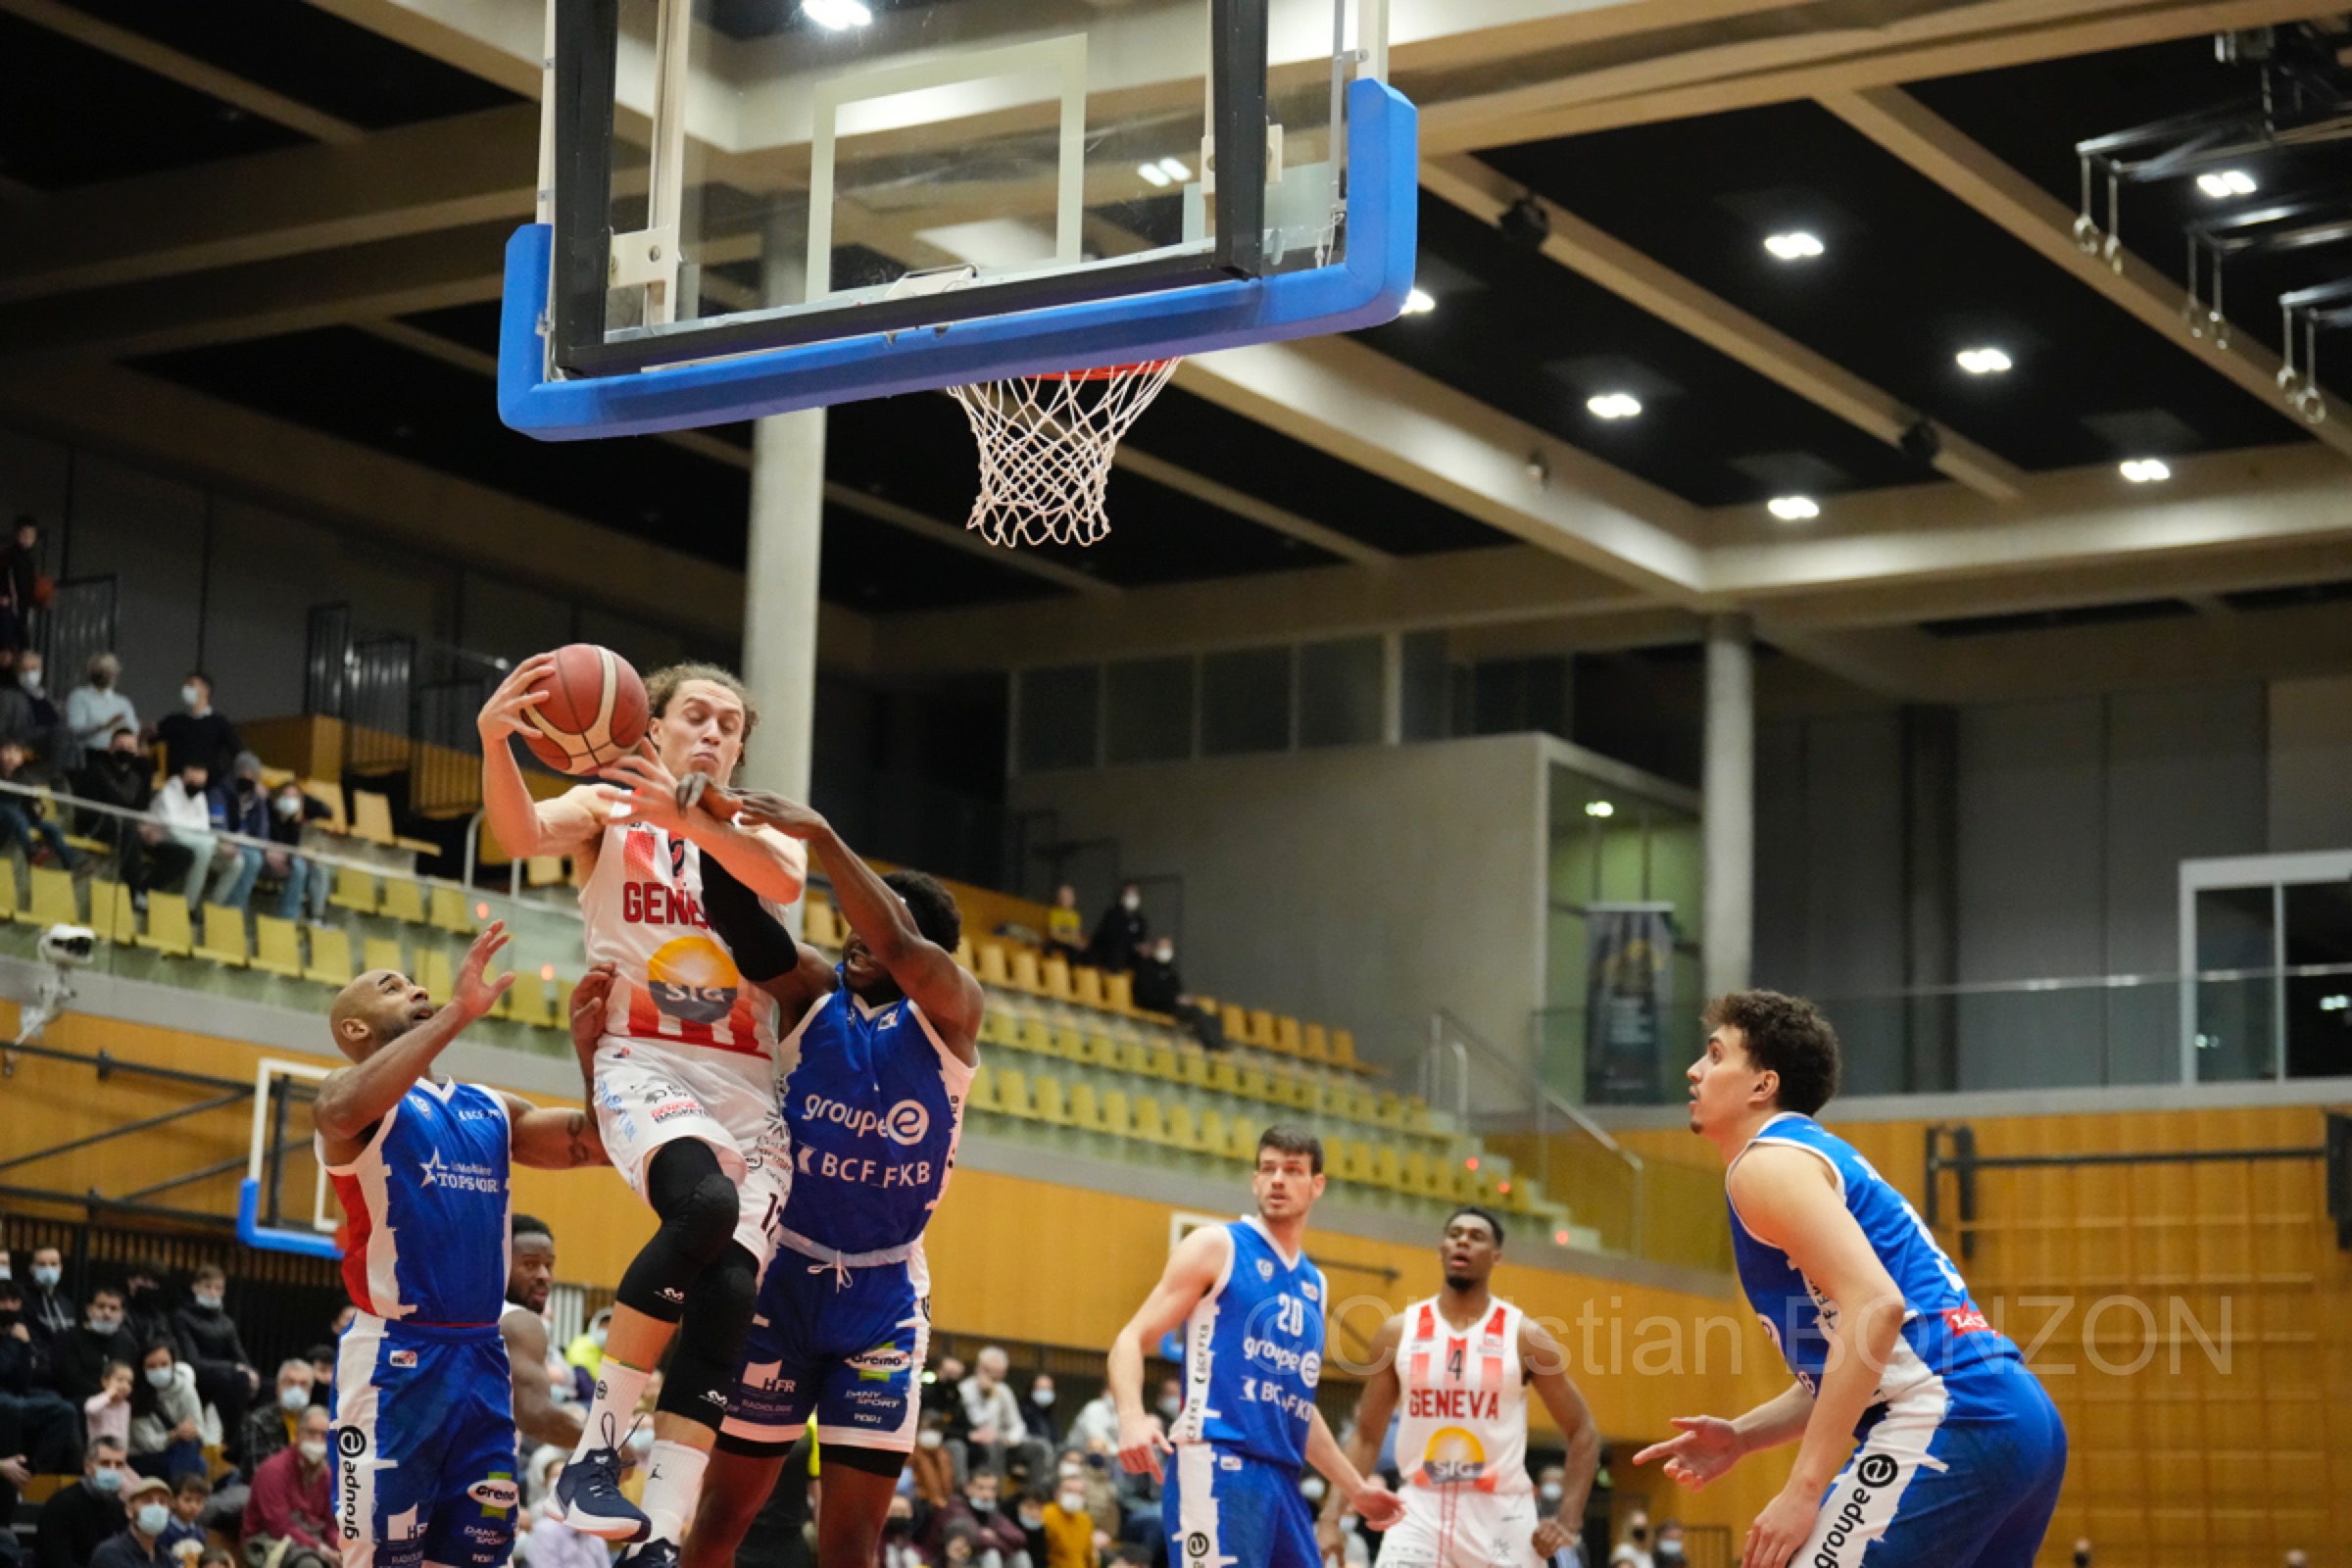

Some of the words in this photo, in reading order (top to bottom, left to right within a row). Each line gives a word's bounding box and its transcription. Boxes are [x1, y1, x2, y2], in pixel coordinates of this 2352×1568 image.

[622, 881, 709, 930] GENE
[801, 1093, 890, 1138] groupe
[820, 1152, 877, 1183] BCF
[883, 1161, 931, 1189] FKB
[1278, 1293, 1304, 1338] 20
[1243, 1337, 1300, 1371] groupe
[1447, 1348, 1463, 1381] 4
[1408, 1388, 1500, 1420] GENEVA
[343, 1459, 362, 1540] groupe
[1813, 1487, 1872, 1568] groupe
